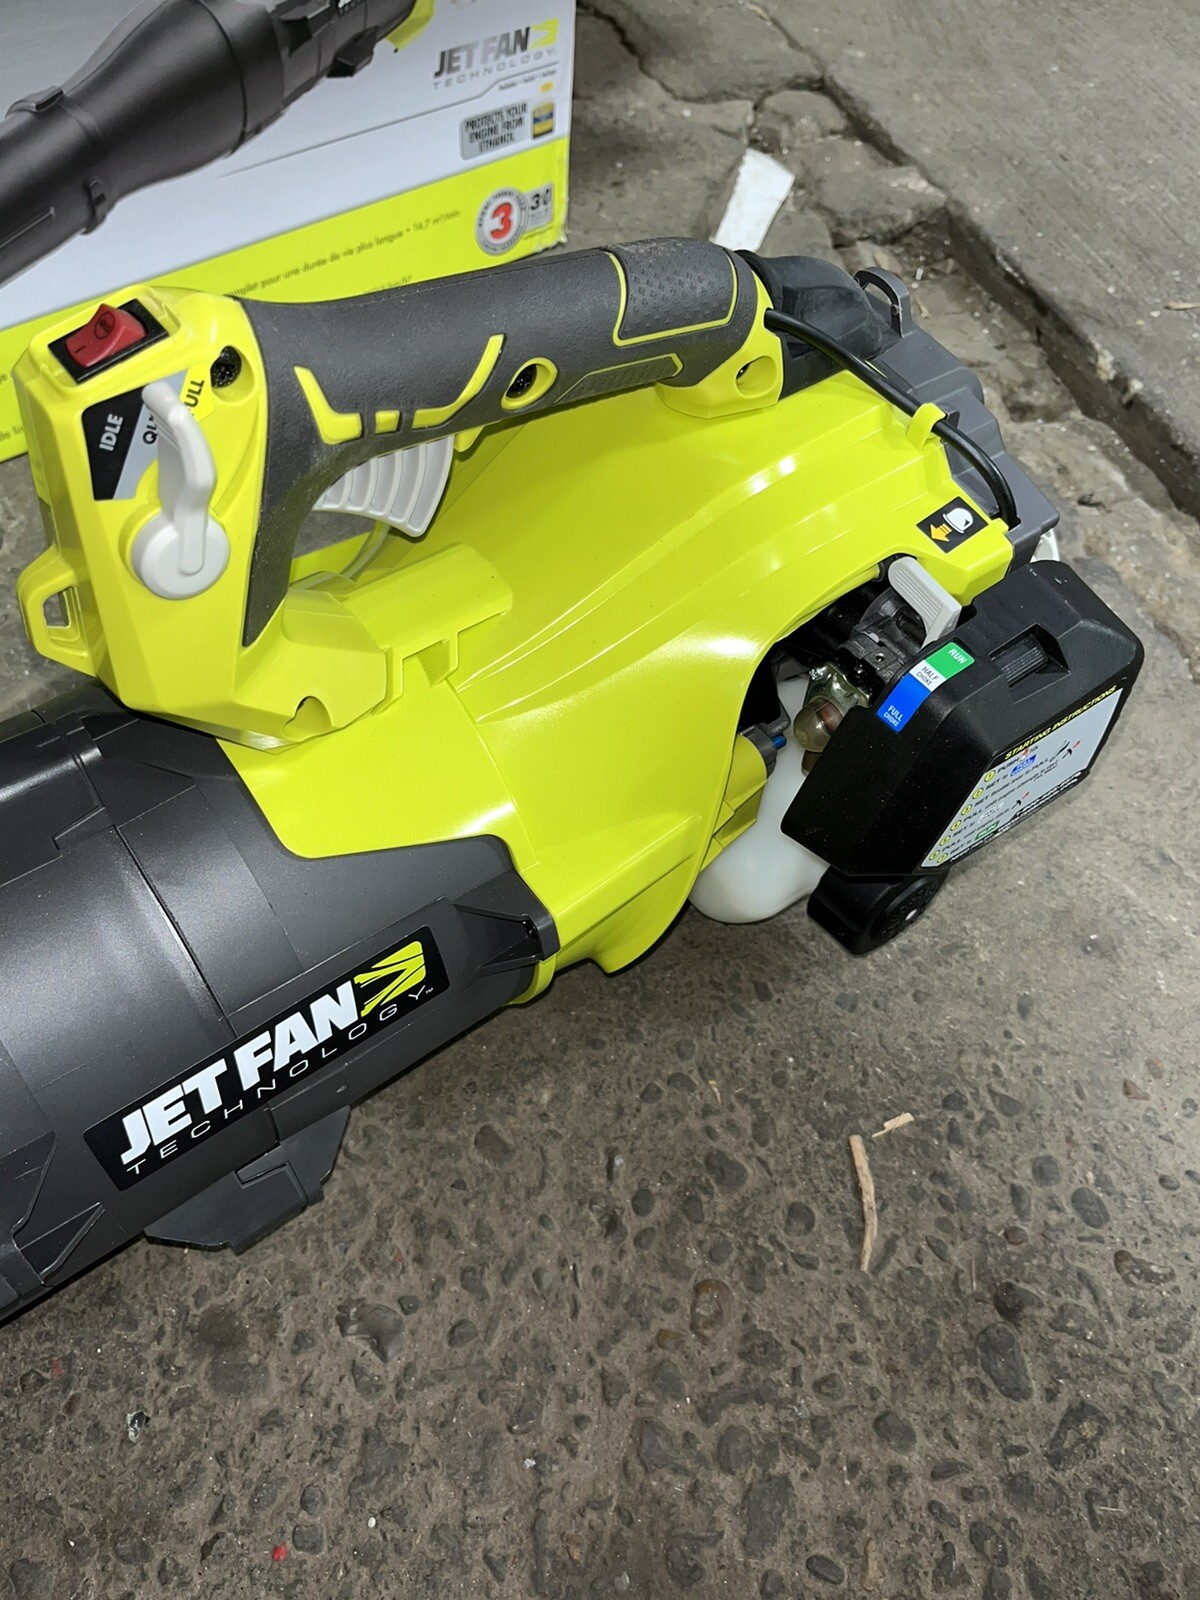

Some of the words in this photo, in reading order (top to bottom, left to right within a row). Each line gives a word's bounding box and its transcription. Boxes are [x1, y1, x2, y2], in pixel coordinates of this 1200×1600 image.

[433, 40, 480, 79] JET
[482, 26, 531, 65] FAN
[433, 47, 556, 90] TECHNOLOGY
[490, 202, 512, 240] 3
[183, 379, 205, 416] ULL
[98, 413, 124, 452] IDLE
[921, 666, 939, 681] HALF
[947, 648, 968, 665] RUN
[916, 671, 933, 687] CHOKE
[883, 711, 900, 728] CHOKE
[887, 704, 903, 722] FULL
[1004, 727, 1052, 760] STARTING
[1051, 684, 1118, 731] INSTRUCTIONS
[120, 1058, 228, 1165] JET
[233, 980, 359, 1091] FAN
